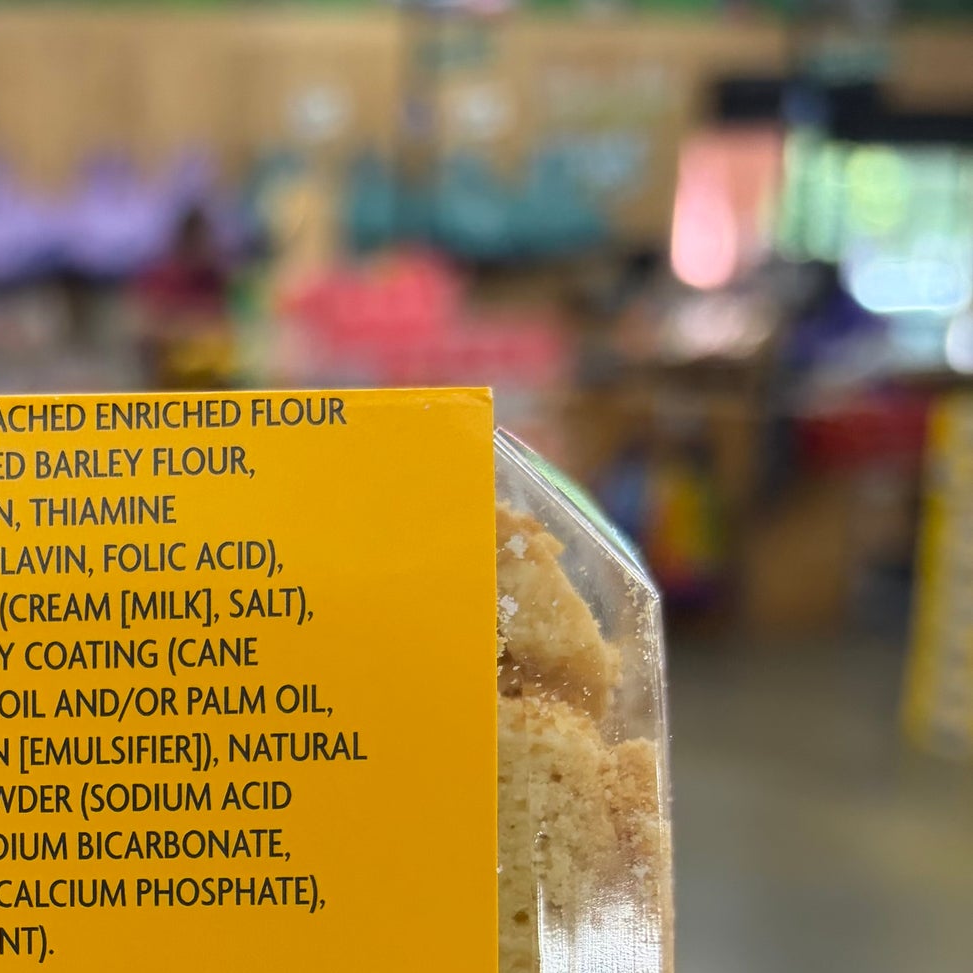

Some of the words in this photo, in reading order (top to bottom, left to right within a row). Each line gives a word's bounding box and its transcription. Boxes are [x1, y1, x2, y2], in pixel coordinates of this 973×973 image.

[97, 400, 241, 430] ENRICHED
[252, 398, 346, 426] FLOUR
[36, 449, 142, 478] BARLEY
[154, 447, 254, 478] FLOUR,
[30, 496, 176, 526] THIAMINE
[104, 543, 185, 572] FOLIC
[196, 540, 282, 577] ACID),
[0, 593, 110, 631] (CREAM
[122, 588, 219, 629] [MILK],
[230, 586, 313, 625] SALT),
[25, 639, 157, 670] COATING
[169, 637, 258, 676] (CANE
[54, 688, 178, 722] AND/OR
[188, 686, 265, 715] PALM
[276, 685, 332, 717] OIL,
[20, 733, 218, 774] [EMULSIFIER]),
[229, 732, 367, 762] NATURAL
[81, 783, 211, 821] (SODIUM
[221, 781, 291, 810] ACID
[78, 829, 290, 861] BICARBONATE,
[137, 875, 325, 913] PHOSPHATE),
